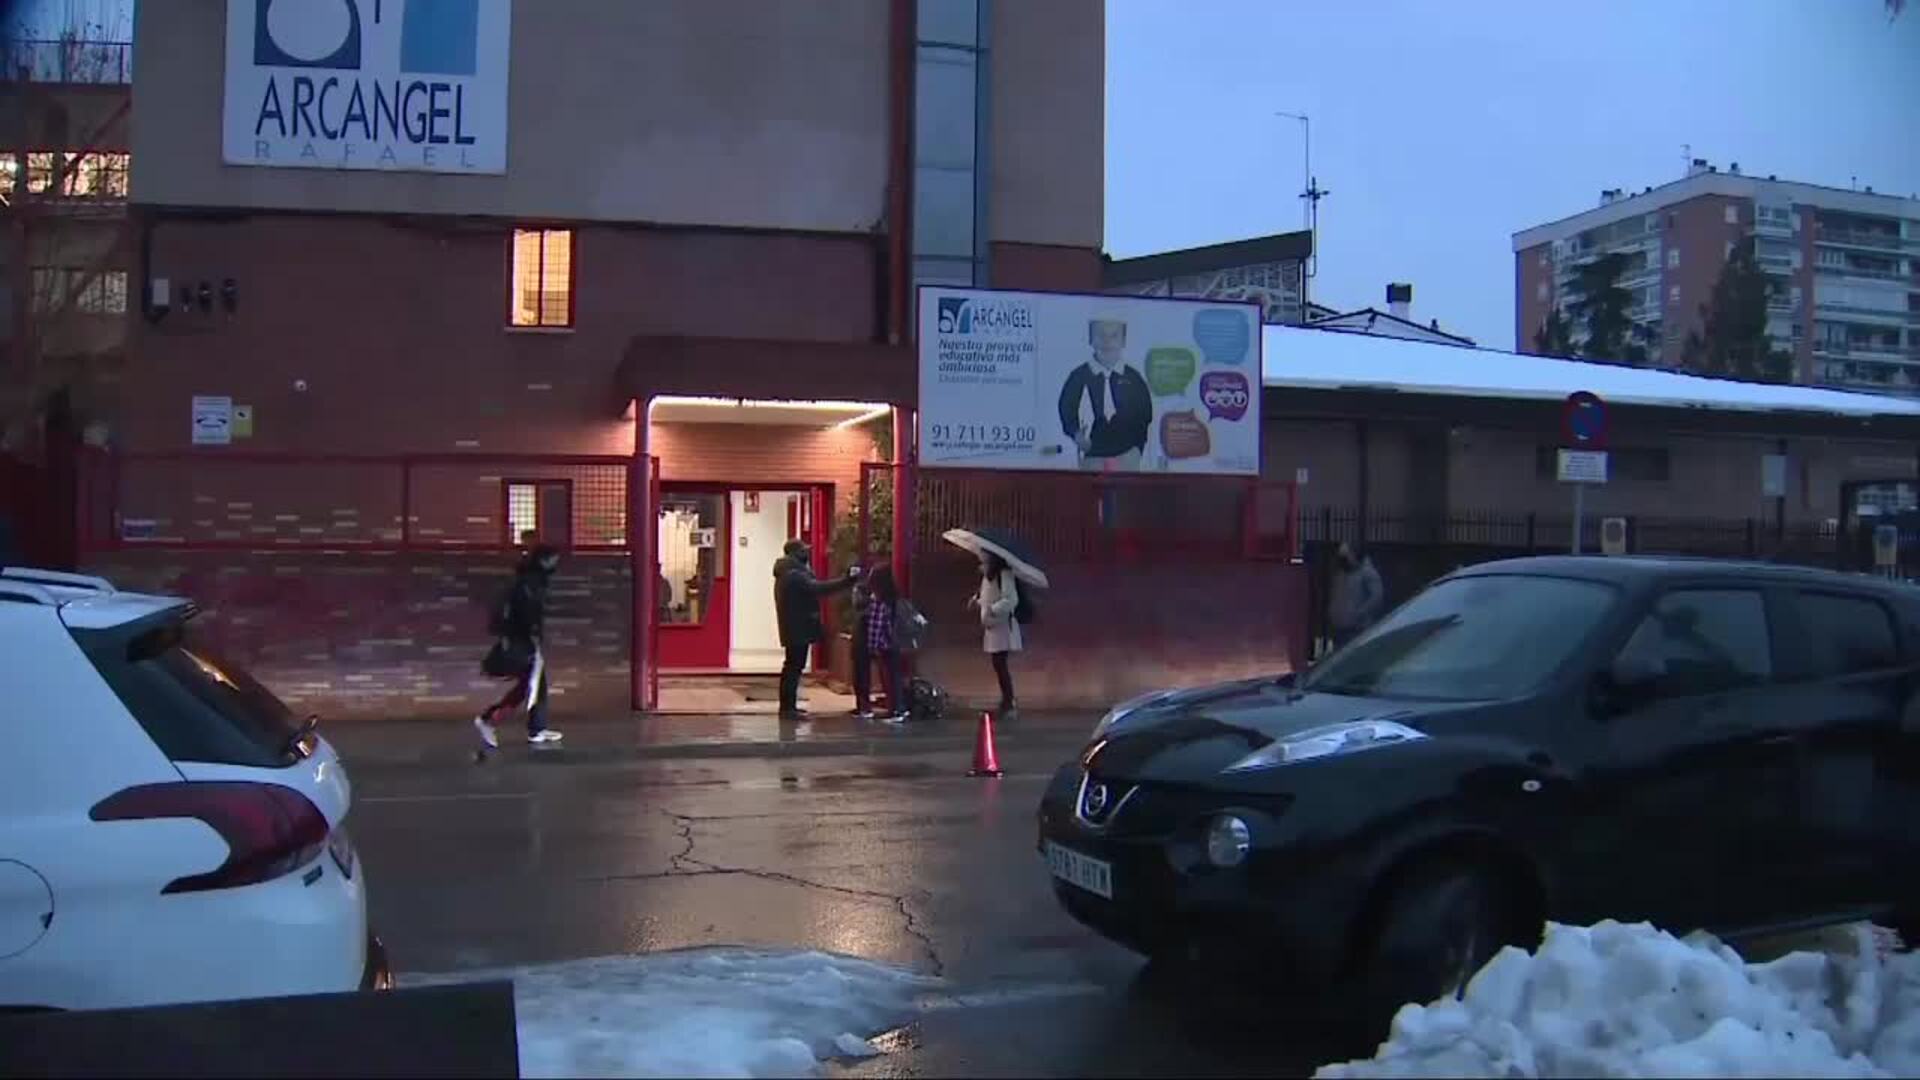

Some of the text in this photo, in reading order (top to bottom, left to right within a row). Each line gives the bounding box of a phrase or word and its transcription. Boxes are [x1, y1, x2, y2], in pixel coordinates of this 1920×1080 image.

[255, 74, 476, 145] ARCANGEL
[254, 139, 476, 168] RAFAEL
[972, 307, 1032, 328] ARCANGEL
[938, 350, 994, 362] educativo
[985, 342, 1034, 353] proyecto
[932, 424, 1036, 441] 91 711 93 00
